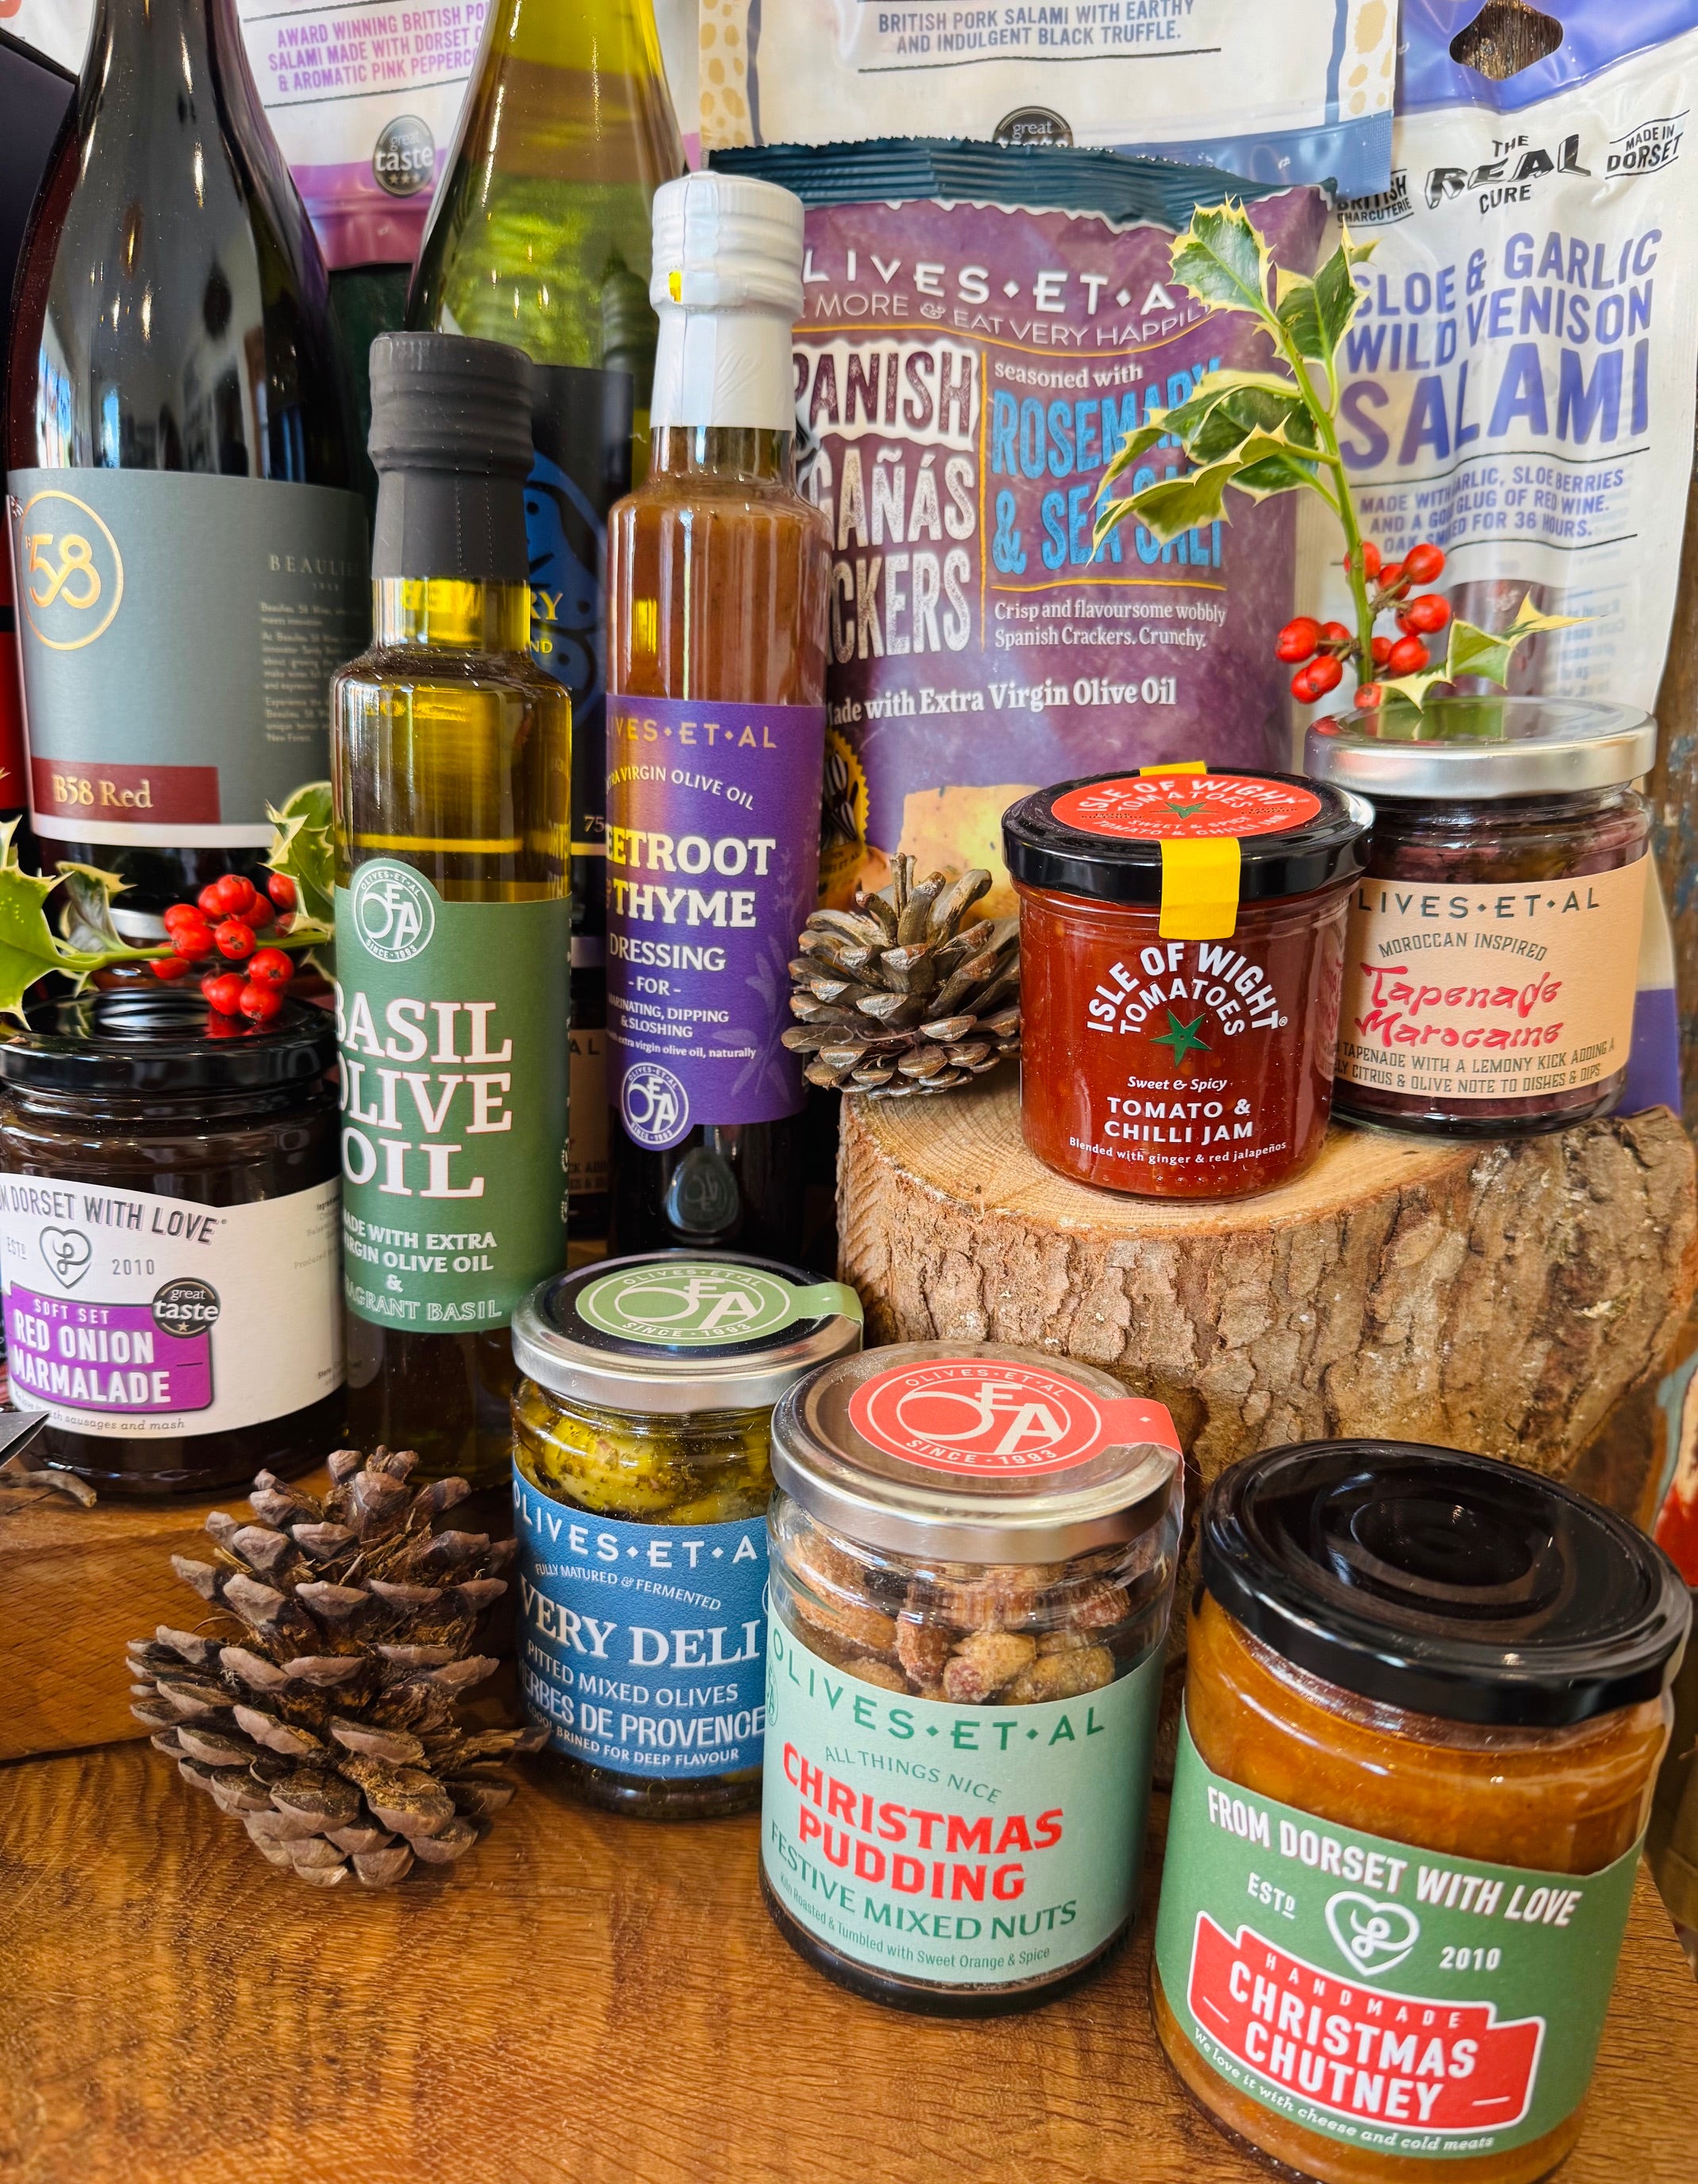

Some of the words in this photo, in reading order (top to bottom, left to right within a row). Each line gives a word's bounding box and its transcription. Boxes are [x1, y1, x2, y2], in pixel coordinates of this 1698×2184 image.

[278, 26, 328, 48] AWARD
[332, 15, 397, 40] WINNING
[402, 6, 461, 33] BRITISH
[878, 12, 947, 34] BRITISH
[953, 9, 1000, 30] PORK
[1004, 6, 1069, 25] SALAMI
[1074, 2, 1123, 24] WITH
[1127, 0, 1193, 21] EARTHY
[268, 48, 323, 71] SALAMI
[328, 42, 367, 64] MADE
[372, 37, 409, 58] WITH
[415, 28, 470, 52] DORSET
[897, 33, 932, 54] AND
[936, 28, 1032, 52] INDULGENT
[1038, 24, 1096, 46] BLACK
[1101, 20, 1181, 44] TRUFFLE.
[294, 65, 367, 90] AROMATIC
[372, 60, 407, 82] PINK
[390, 133, 421, 151] great
[1492, 136, 1529, 157] THE
[1607, 133, 1683, 171] DORSET
[1626, 127, 1658, 151] MADE
[375, 145, 433, 171] taste
[1425, 134, 1591, 210] REAL
[1337, 197, 1412, 223] CHARCUTERIE
[1479, 184, 1531, 215] CURE
[1351, 264, 1456, 317] SLOE
[1503, 229, 1662, 290] GARLIC
[814, 291, 909, 319] MORE
[1347, 316, 1457, 374] WILD
[1466, 279, 1654, 350] VENISON
[994, 362, 1089, 388] seasoned
[1093, 363, 1142, 388] with
[1339, 337, 1650, 471] SALAMI
[1360, 495, 1408, 513] MADE
[1370, 515, 1404, 534] AND
[1456, 490, 1497, 514] GLUG
[1504, 487, 1527, 507] OF
[1534, 489, 1557, 510] RED
[1561, 494, 1611, 515] WINE.
[993, 488, 1027, 575] &
[1472, 510, 1506, 532] FOR
[1542, 514, 1592, 536] HOURS.
[994, 601, 1039, 622] Crisp
[1043, 601, 1070, 618] and
[1074, 600, 1173, 619] flavoursome
[1175, 601, 1227, 627] wobbly
[994, 628, 1058, 651] Spanish
[1061, 626, 1135, 646] Crackers.
[1139, 626, 1207, 649] Crunchy.
[864, 689, 915, 721] with
[919, 687, 984, 714] Extra
[989, 679, 1070, 713] Virgin
[1073, 679, 1138, 707] Olive
[52, 774, 94, 806] B58
[100, 779, 153, 808] Red
[1077, 789, 1131, 811] ISLE
[1133, 780, 1174, 793] OF
[1117, 791, 1253, 811] TOMATOES
[613, 883, 757, 928] THYME
[610, 932, 726, 971] DRESSING
[1378, 932, 1467, 958] MOROCCAN
[1474, 932, 1547, 961] INSPIRED
[1086, 962, 1139, 1032] ISLE
[1139, 942, 1185, 977] OF
[1359, 962, 1562, 1018] Tapenade
[335, 980, 513, 1064] BASIL
[1120, 979, 1245, 1037] TOMATOES
[1355, 1009, 1564, 1051] Marocaine
[636, 1040, 661, 1054] virgin
[663, 1044, 687, 1056] olive
[709, 1048, 756, 1059] naturally
[1343, 1042, 1405, 1067] TAPENADE
[1412, 1055, 1450, 1072] WITH
[1472, 1058, 1531, 1073] LEMONY
[1537, 1052, 1566, 1068] KICK
[1570, 1044, 1607, 1065] ADDING
[1128, 1076, 1170, 1090] Sweet
[1191, 1077, 1227, 1093] Spicy
[1351, 1065, 1392, 1086] CITRUS
[1411, 1075, 1451, 1093] OLIVE
[1458, 1079, 1495, 1094] NOTE
[1522, 1071, 1565, 1091] DISHES
[1107, 1097, 1223, 1117] TOMATO
[1235, 1099, 1250, 1115] &
[1104, 1121, 1191, 1143] CHILLI
[1201, 1122, 1253, 1144] JAM
[342, 1126, 484, 1198] OIL
[1070, 1137, 1113, 1157] Blended
[1117, 1149, 1144, 1161] with
[1148, 1153, 1190, 1167] ginger
[1209, 1150, 1229, 1163] red
[10, 1186, 76, 1220] DORSET
[83, 1194, 146, 1231] WITH
[367, 1223, 419, 1249] WITH
[426, 1232, 497, 1250] EXTRA
[112, 1259, 156, 1275] 2010
[383, 1252, 448, 1273] OLIVE
[452, 1255, 494, 1272] OIL
[171, 1286, 206, 1302] great
[386, 1274, 403, 1293] &
[33, 1298, 68, 1321] SOFT
[79, 1307, 109, 1325] SET
[153, 1299, 220, 1321] taste
[427, 1299, 502, 1321] BASIL
[12, 1308, 51, 1352] RED
[58, 1324, 155, 1364] ONION
[12, 1344, 171, 1404] MARMALADE
[65, 1414, 117, 1430] sausages
[121, 1420, 147, 1430] and
[150, 1418, 186, 1429] mash
[905, 1439, 978, 1465] SINCE
[999, 1449, 1058, 1467] 1993
[561, 1564, 618, 1585] MATURED
[636, 1578, 721, 1611] FERMENTED
[521, 1574, 617, 1659] VERY
[628, 1619, 761, 1668] DELI
[528, 1639, 574, 1684] PITTED
[578, 1672, 649, 1704] MIXED
[655, 1683, 739, 1708] OLIVES
[580, 1701, 613, 1739] DE
[620, 1705, 766, 1748] PROVENCE
[603, 1744, 630, 1761] FOR
[633, 1751, 671, 1766] DEEP
[675, 1748, 740, 1767] FLAVOUR
[825, 1746, 855, 1765] ALL
[861, 1751, 940, 1783] THINGS
[947, 1773, 1003, 1805] NICE
[782, 1740, 1064, 1855] CHRISTMAS
[797, 1802, 1027, 1902] PUDDING
[1206, 1785, 1272, 1848] FROM
[1278, 1812, 1408, 1894] DORSET
[1415, 1864, 1502, 1918] WITH
[1504, 1882, 1584, 1928] LOVE
[771, 1819, 857, 1913] FESTIVE
[862, 1894, 982, 1941] MIXED
[990, 1899, 1077, 1940] NUTS
[793, 1886, 827, 1925] Roasted
[837, 1919, 884, 1953] Tumbled
[887, 1942, 913, 1963] with
[917, 1948, 956, 1967] Sweet
[959, 1954, 1005, 1971] Orange
[1018, 1947, 1050, 1967] Spice
[1439, 1944, 1502, 1971] 2010
[1265, 1951, 1463, 2029] HANDMADE
[1228, 1959, 1481, 2078] CHRISTMAS
[1244, 2021, 1443, 2124] CHUTNEY
[1258, 2081, 1295, 2113] with
[1297, 2106, 1358, 2139] cheese
[1360, 2128, 1396, 2147] and
[1400, 2132, 1439, 2151] cold
[1443, 2135, 1493, 2151] meats
